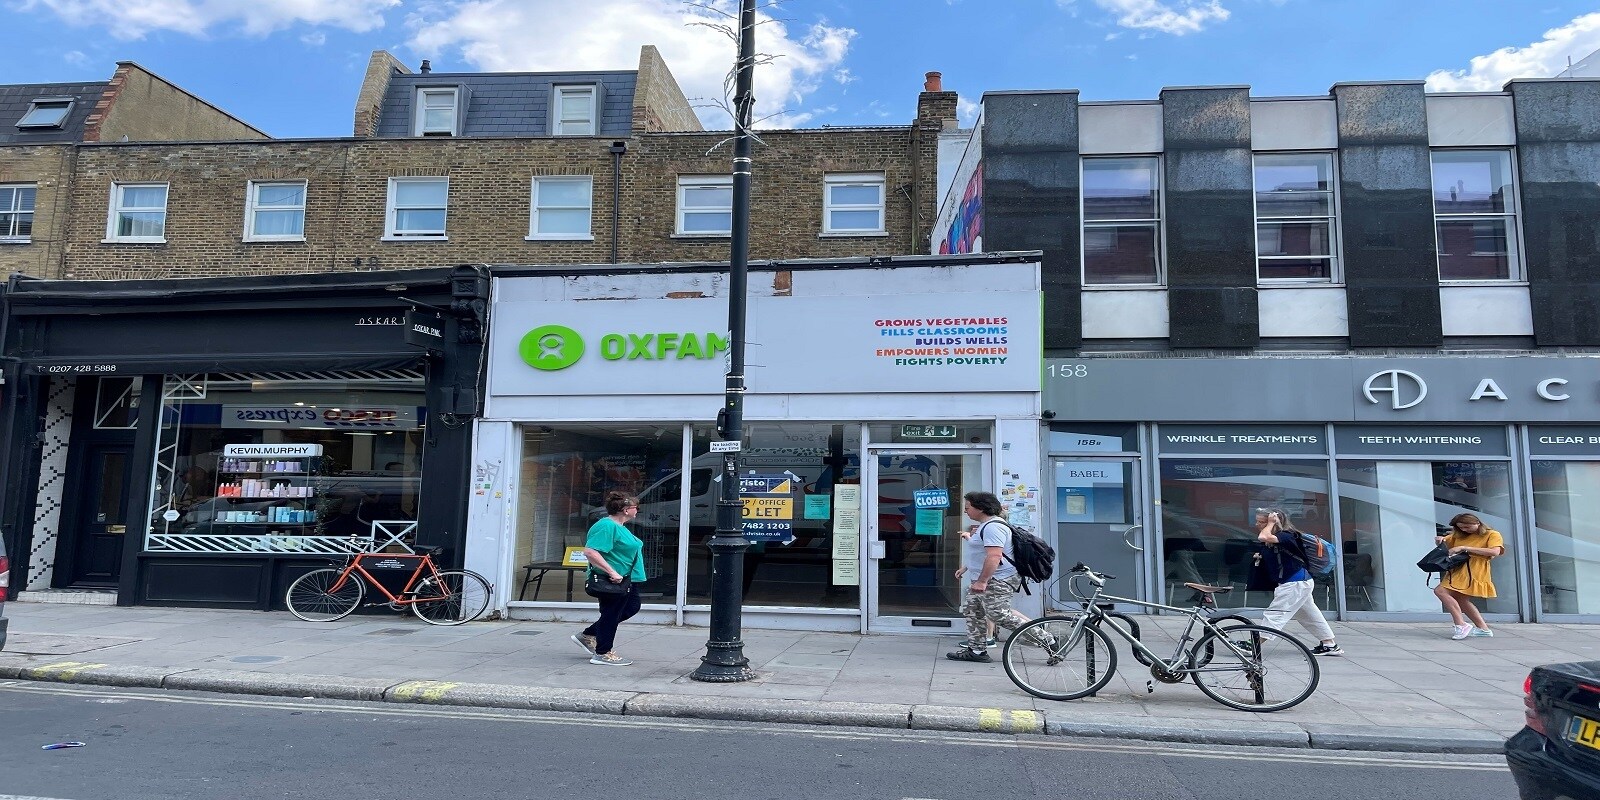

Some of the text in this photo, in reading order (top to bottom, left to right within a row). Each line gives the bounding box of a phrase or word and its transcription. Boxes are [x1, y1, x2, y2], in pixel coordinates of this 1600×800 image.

[359, 316, 398, 325] OSKAR
[874, 317, 1008, 327] GROWS VEGETABLES
[413, 323, 442, 337] OSKAR PINK
[881, 326, 1008, 336] FILLS CLASSROOMS
[915, 336, 1008, 346] BUILDS WELLS
[600, 332, 727, 360] OXFAM
[876, 347, 1008, 356] EMPOWERS WOMEN
[895, 356, 1008, 366] FIGHTS POVERTY
[49, 365, 72, 373] 0207
[94, 364, 117, 372] 5888
[1046, 364, 1088, 378] 158
[1166, 435, 1318, 444] WRINKLE TREATMENTS
[1358, 436, 1482, 445] TEETH WHITENING
[1539, 436, 1600, 444] CLEAR B
[230, 447, 309, 455] KEVIN.MURPHY
[1069, 470, 1109, 479] BABEL
[916, 496, 947, 506] CLOSED
[756, 507, 782, 517] LET
[766, 522, 791, 530] 1203
